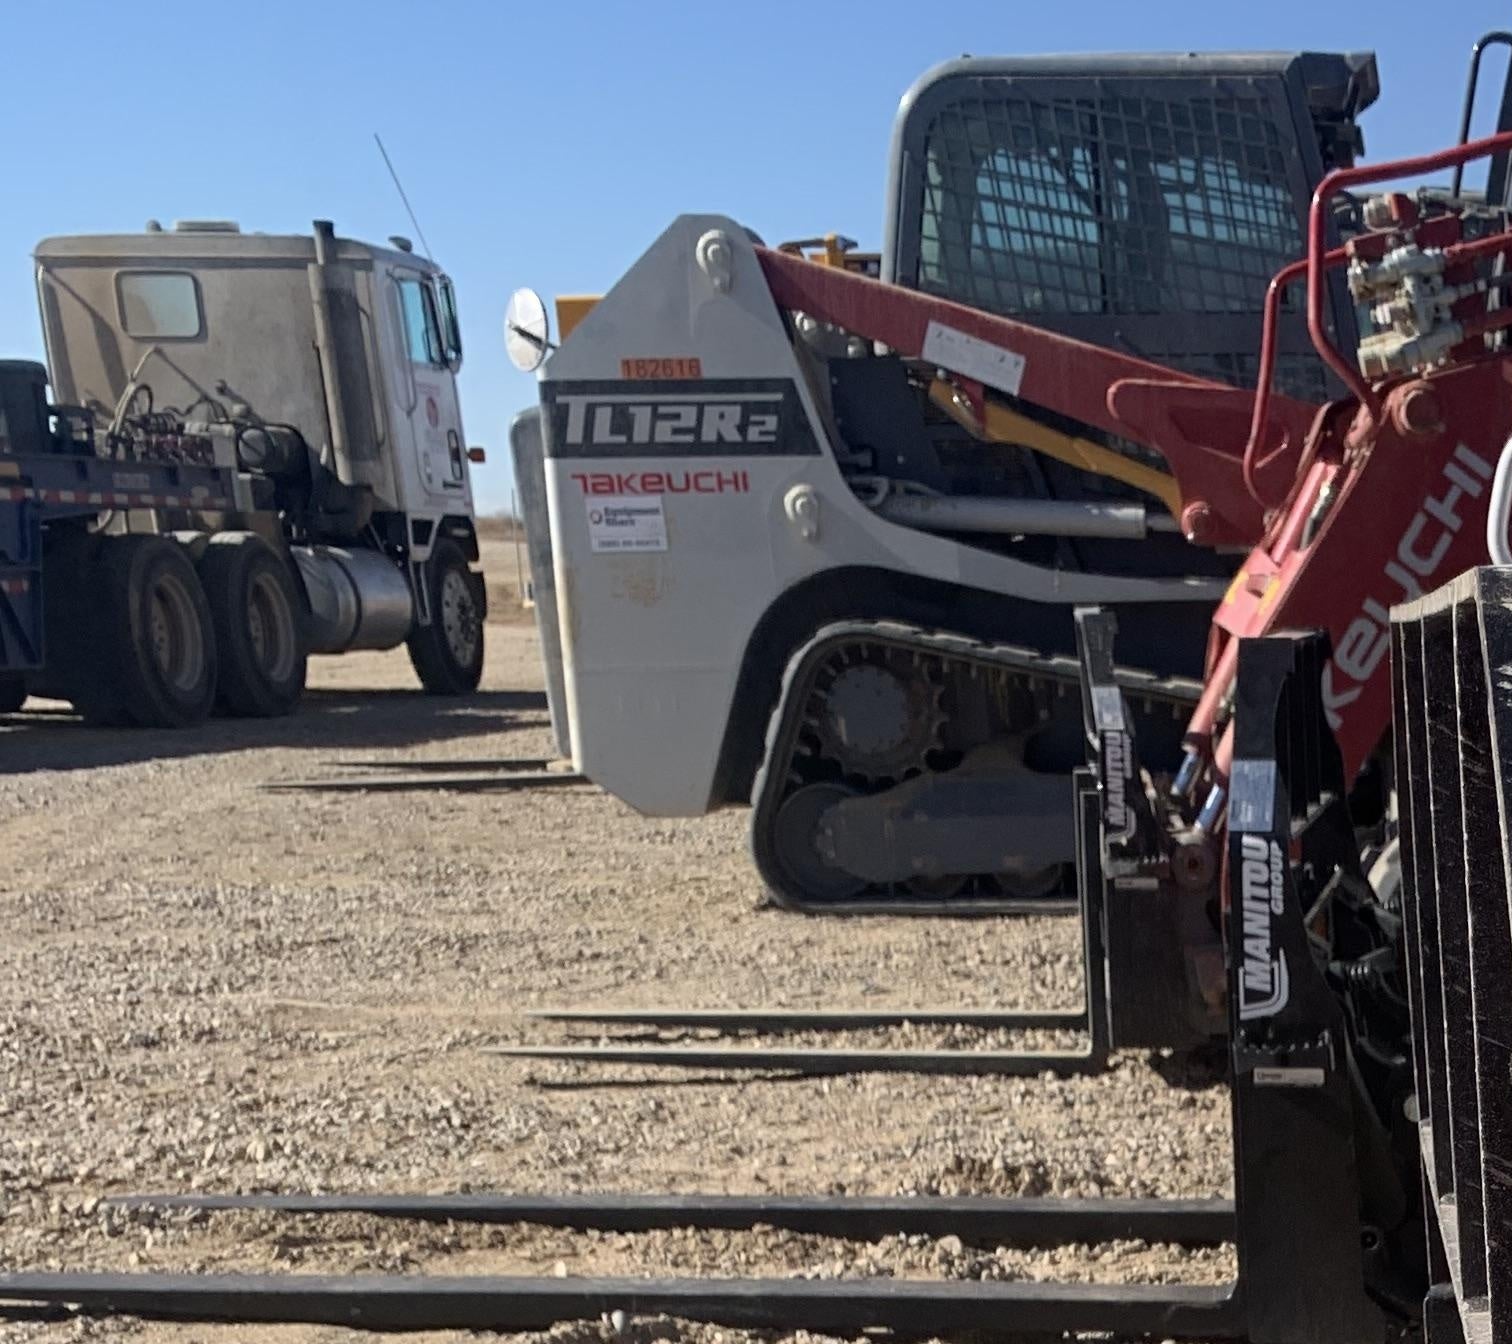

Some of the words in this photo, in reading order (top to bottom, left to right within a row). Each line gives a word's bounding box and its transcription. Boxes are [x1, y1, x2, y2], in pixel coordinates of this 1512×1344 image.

[556, 394, 783, 444] TL12R2
[571, 471, 750, 496] TAKEUCHI
[1241, 834, 1272, 992] MANITOU
